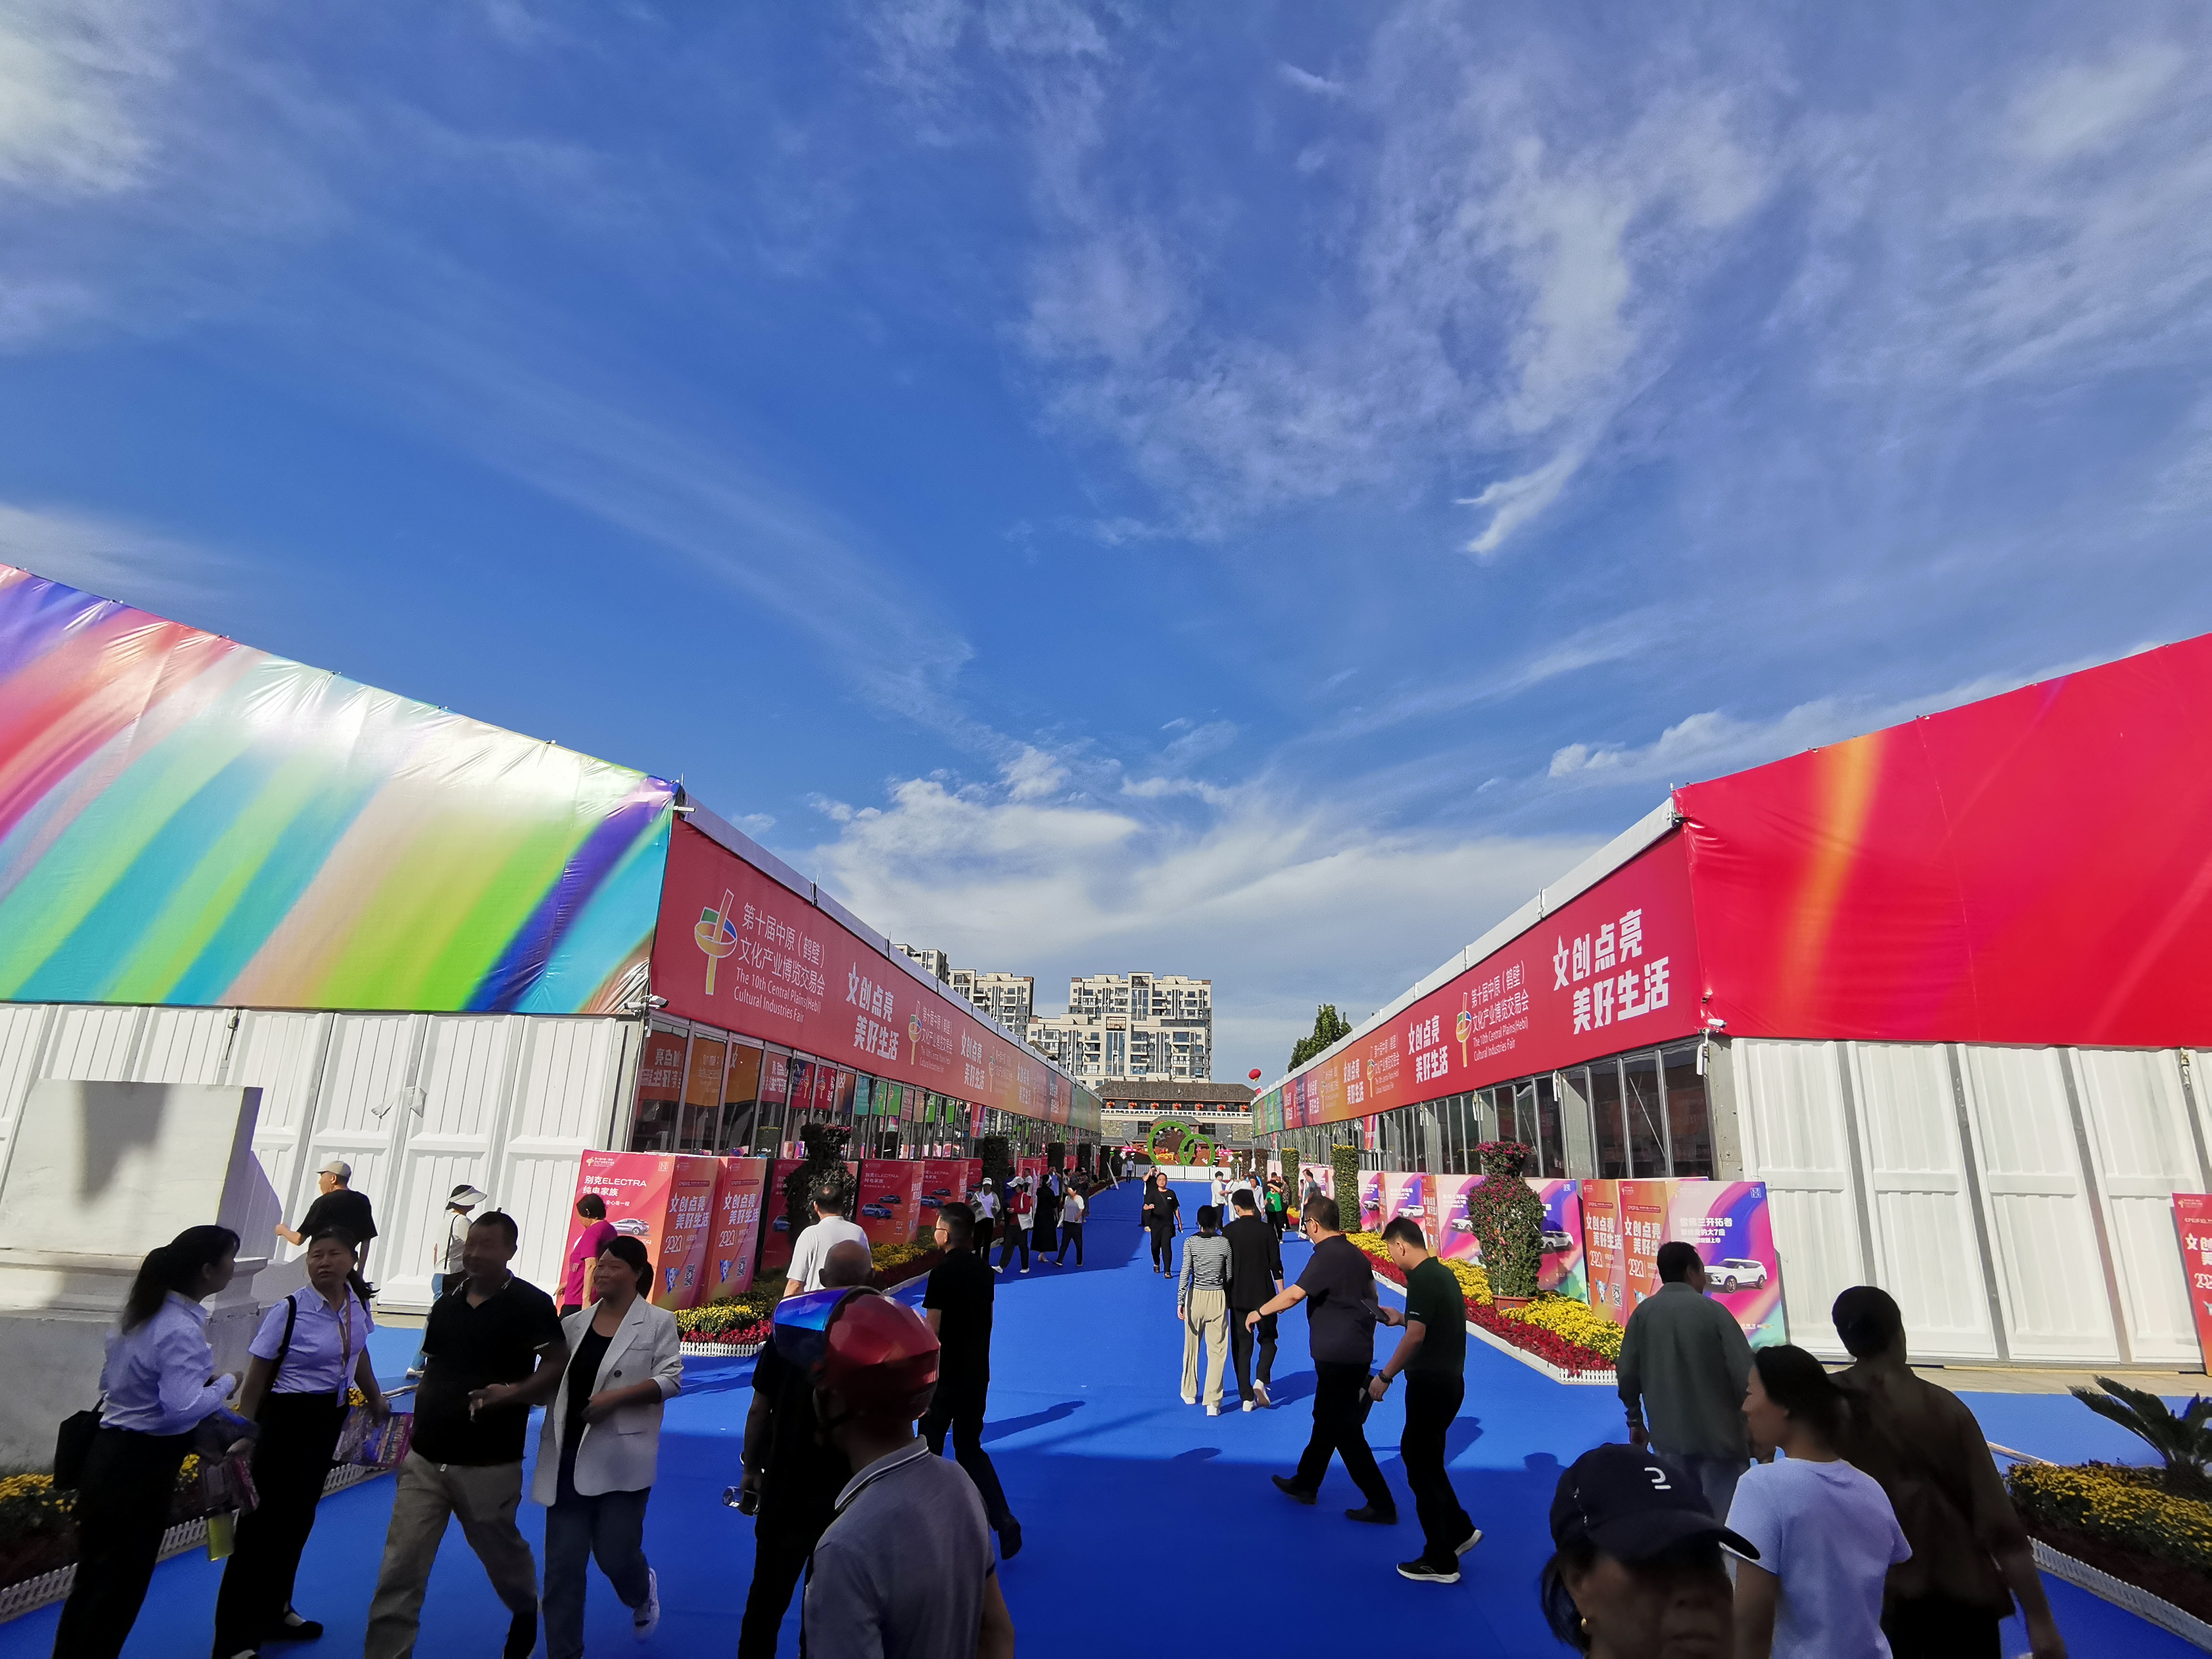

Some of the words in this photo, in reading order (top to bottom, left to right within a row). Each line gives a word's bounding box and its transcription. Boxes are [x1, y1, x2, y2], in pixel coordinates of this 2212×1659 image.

[1553, 908, 1642, 991] 文创点亮
[738, 937, 825, 997] 文化产业博览交易会
[737, 967, 749, 985] The
[752, 974, 766, 991] 10th
[768, 980, 789, 1000] Central
[846, 962, 894, 1022] 文创点亮
[1573, 956, 1669, 1035] 美好生活
[734, 986, 762, 1009] Cultural
[763, 996, 793, 1019] Industries
[793, 1008, 805, 1023] Fair
[853, 1014, 899, 1060] 美好生活
[1408, 1015, 1439, 1055] 文创点亮
[1416, 1045, 1448, 1084] 美好生活
[582, 1185, 619, 1196] 纯电家族
[584, 1175, 647, 1187] 别克ELECTRA
[669, 1192, 707, 1213] 文创点亮
[723, 1190, 756, 1210] 文创点亮
[674, 1212, 710, 1230] 美好生活
[728, 1208, 759, 1226] 美好生活
[1586, 1212, 1614, 1233] 文创点亮
[1624, 1215, 1661, 1240] 文创点亮
[1593, 1231, 1622, 1250] 美好生活
[1634, 1237, 1659, 1256] 美好生
